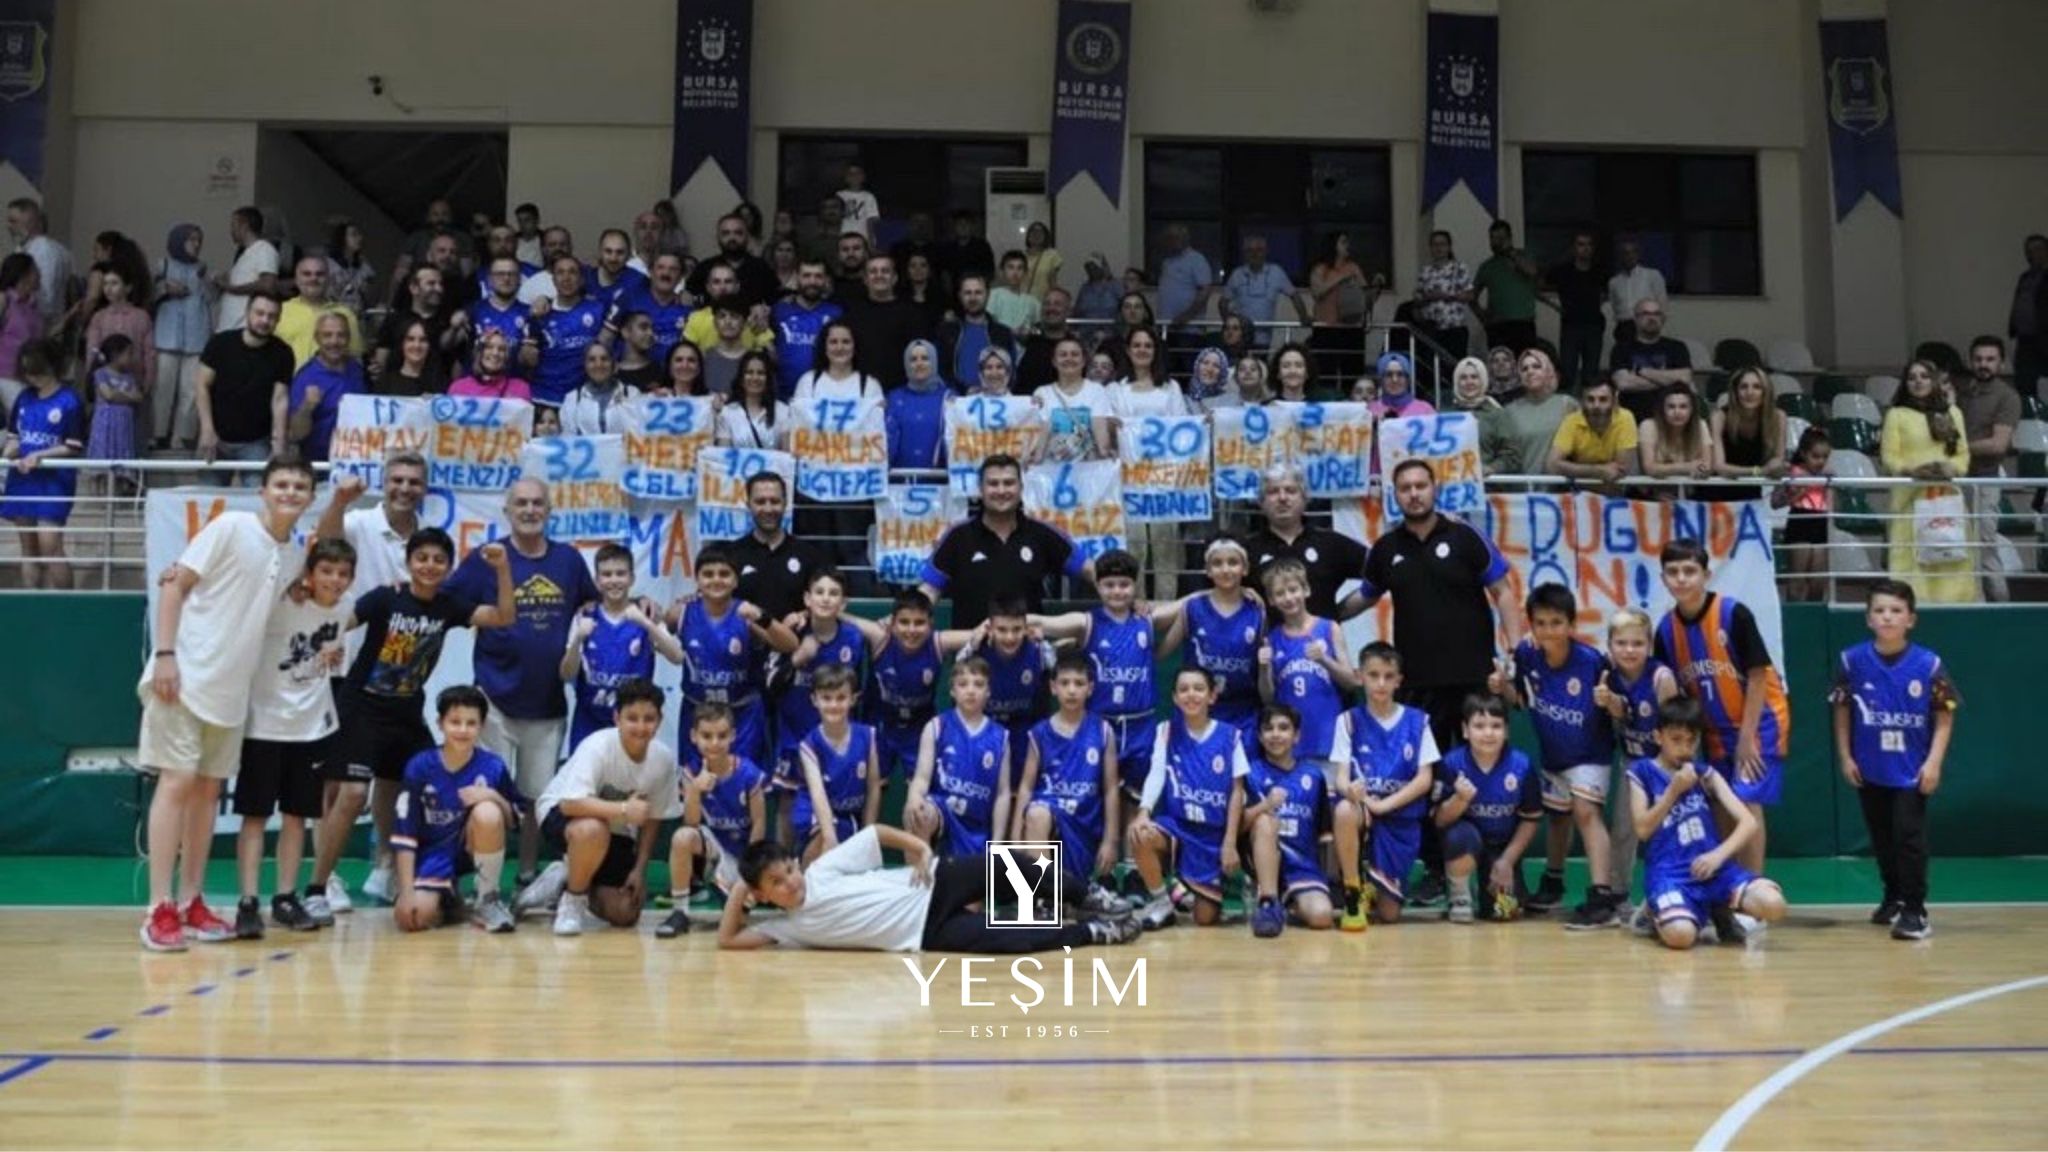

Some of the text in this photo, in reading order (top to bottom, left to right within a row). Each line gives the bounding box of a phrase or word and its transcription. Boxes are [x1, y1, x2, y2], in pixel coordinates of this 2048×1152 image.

[683, 76, 738, 88] BURSA
[1059, 80, 1123, 97] BURSA
[1432, 110, 1490, 127] BURSA
[645, 400, 694, 434] 23
[814, 398, 857, 432] 17
[967, 397, 1007, 430] 13
[1244, 405, 1269, 444] 9
[796, 427, 885, 464] BARLAS
[1140, 418, 1205, 458] 30
[1407, 415, 1466, 455] 25
[545, 437, 599, 480] 32
[723, 447, 765, 478] 10
[903, 487, 938, 516] 5
[1053, 463, 1078, 509] 6
[1294, 677, 1306, 697] 9
[1701, 681, 1713, 701] 7
